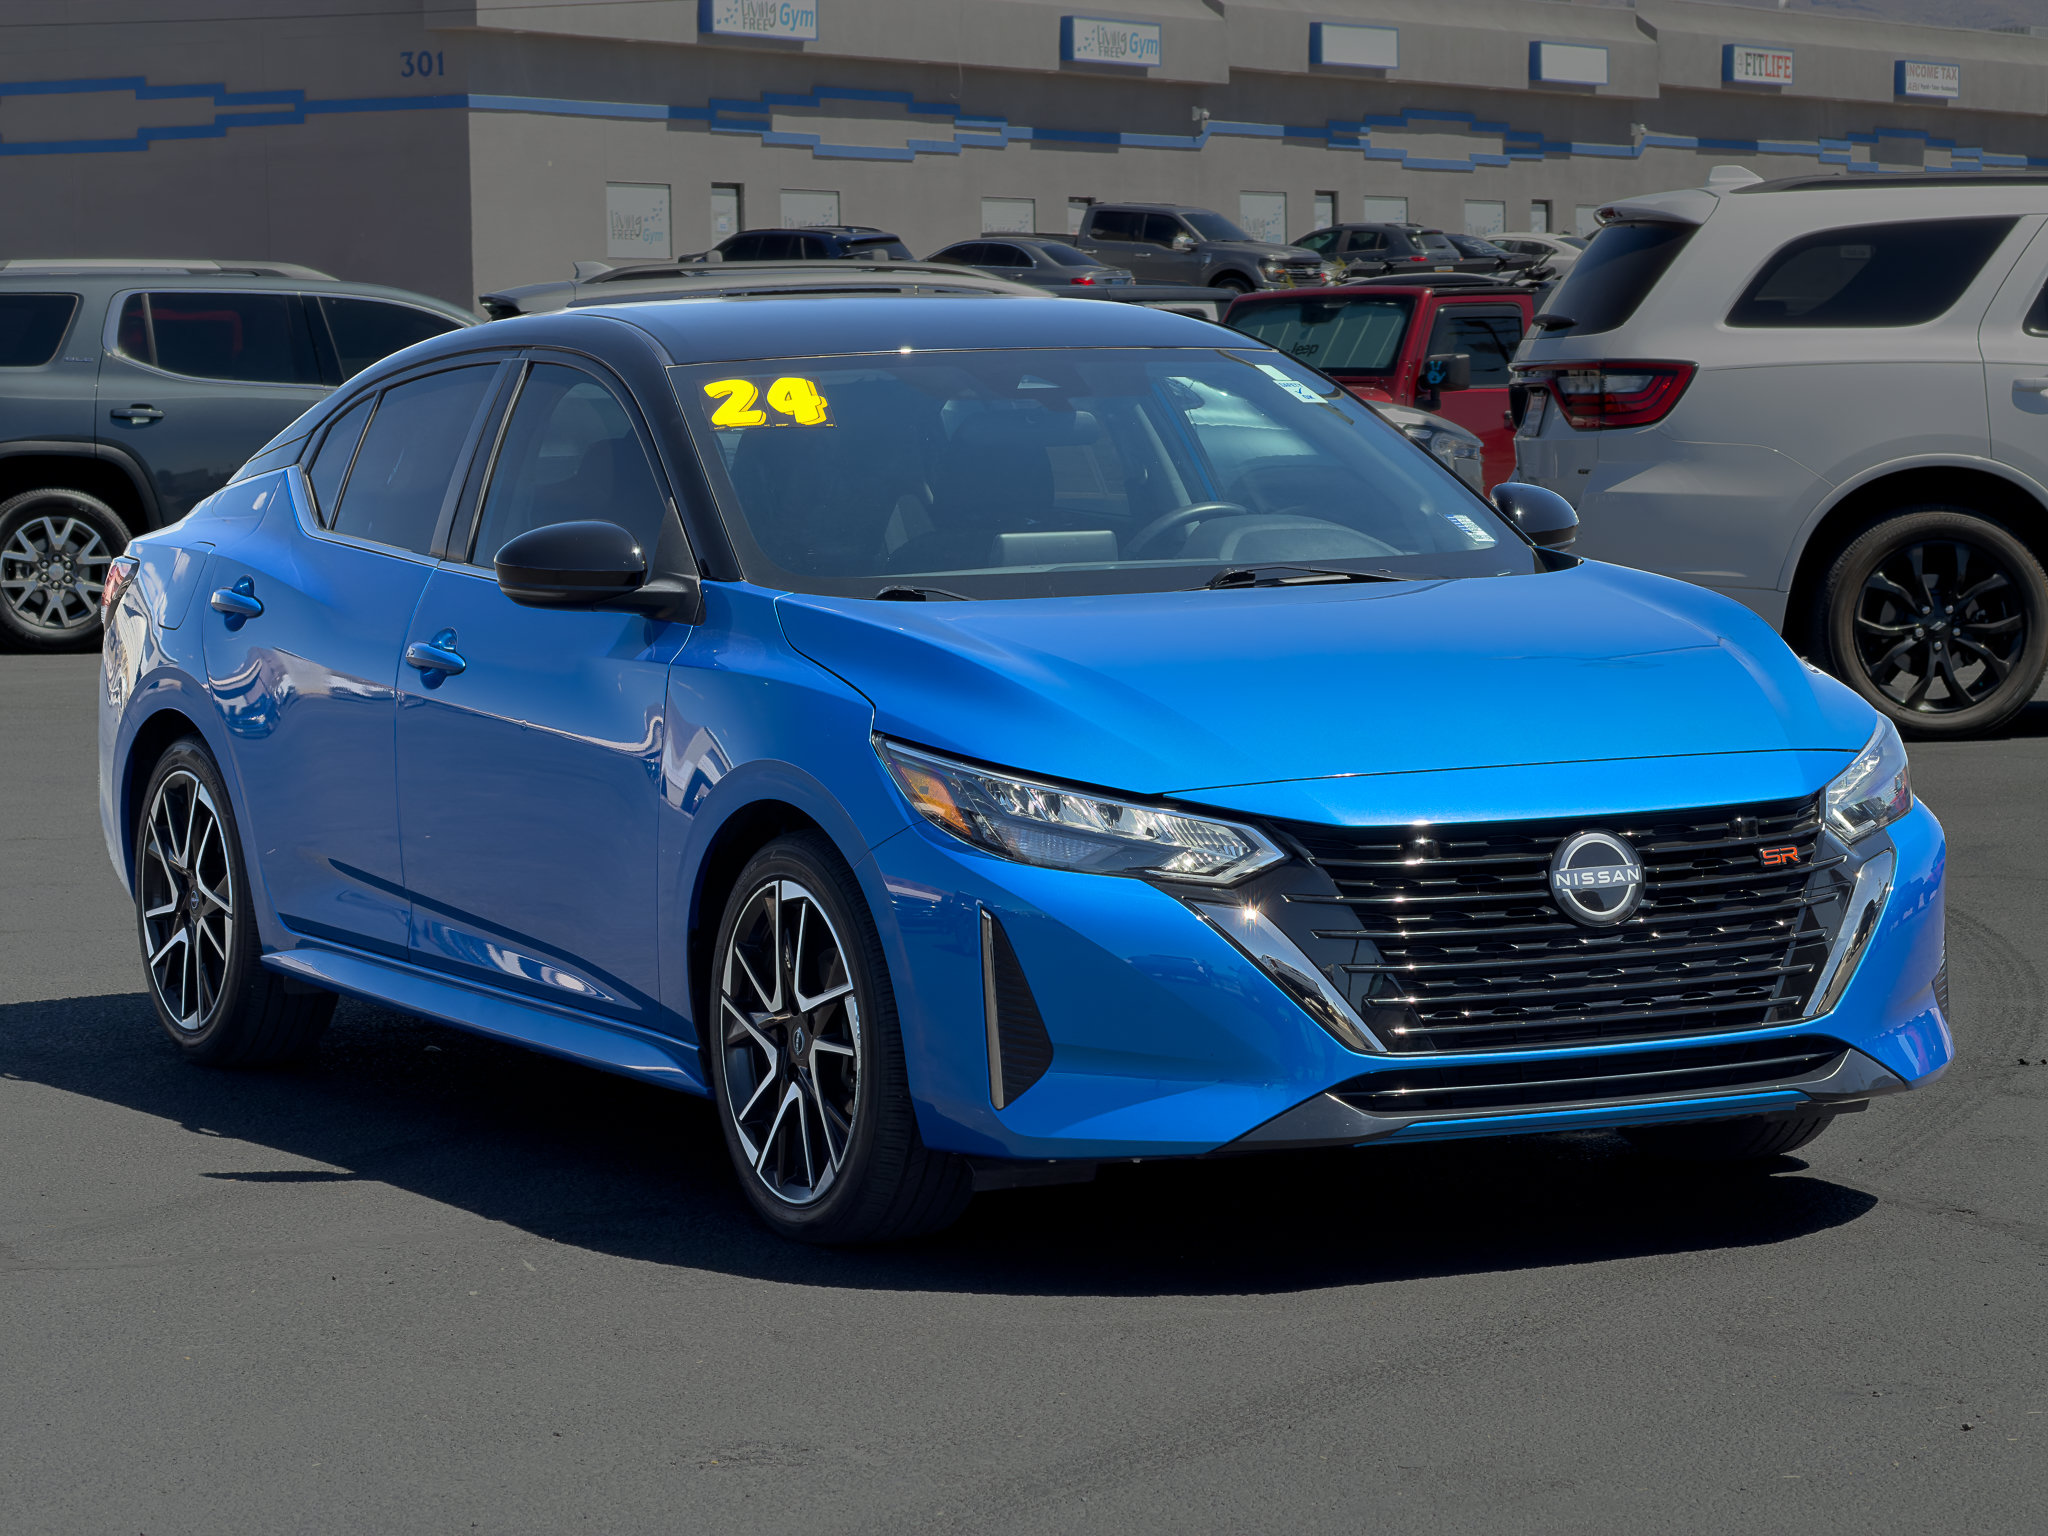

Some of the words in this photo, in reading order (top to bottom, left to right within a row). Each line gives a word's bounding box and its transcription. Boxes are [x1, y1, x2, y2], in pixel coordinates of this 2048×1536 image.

[742, 17, 769, 31] FREE
[780, 3, 815, 31] Gym
[1097, 25, 1127, 56] Living
[1098, 46, 1121, 58] FREE
[1129, 32, 1158, 59] Gym
[400, 51, 444, 78] 301
[1906, 64, 1939, 80] INCOME
[1941, 67, 1957, 81] TAX
[703, 377, 828, 427] 24
[1761, 846, 1799, 866] SR
[1555, 867, 1641, 887] NISSAN
